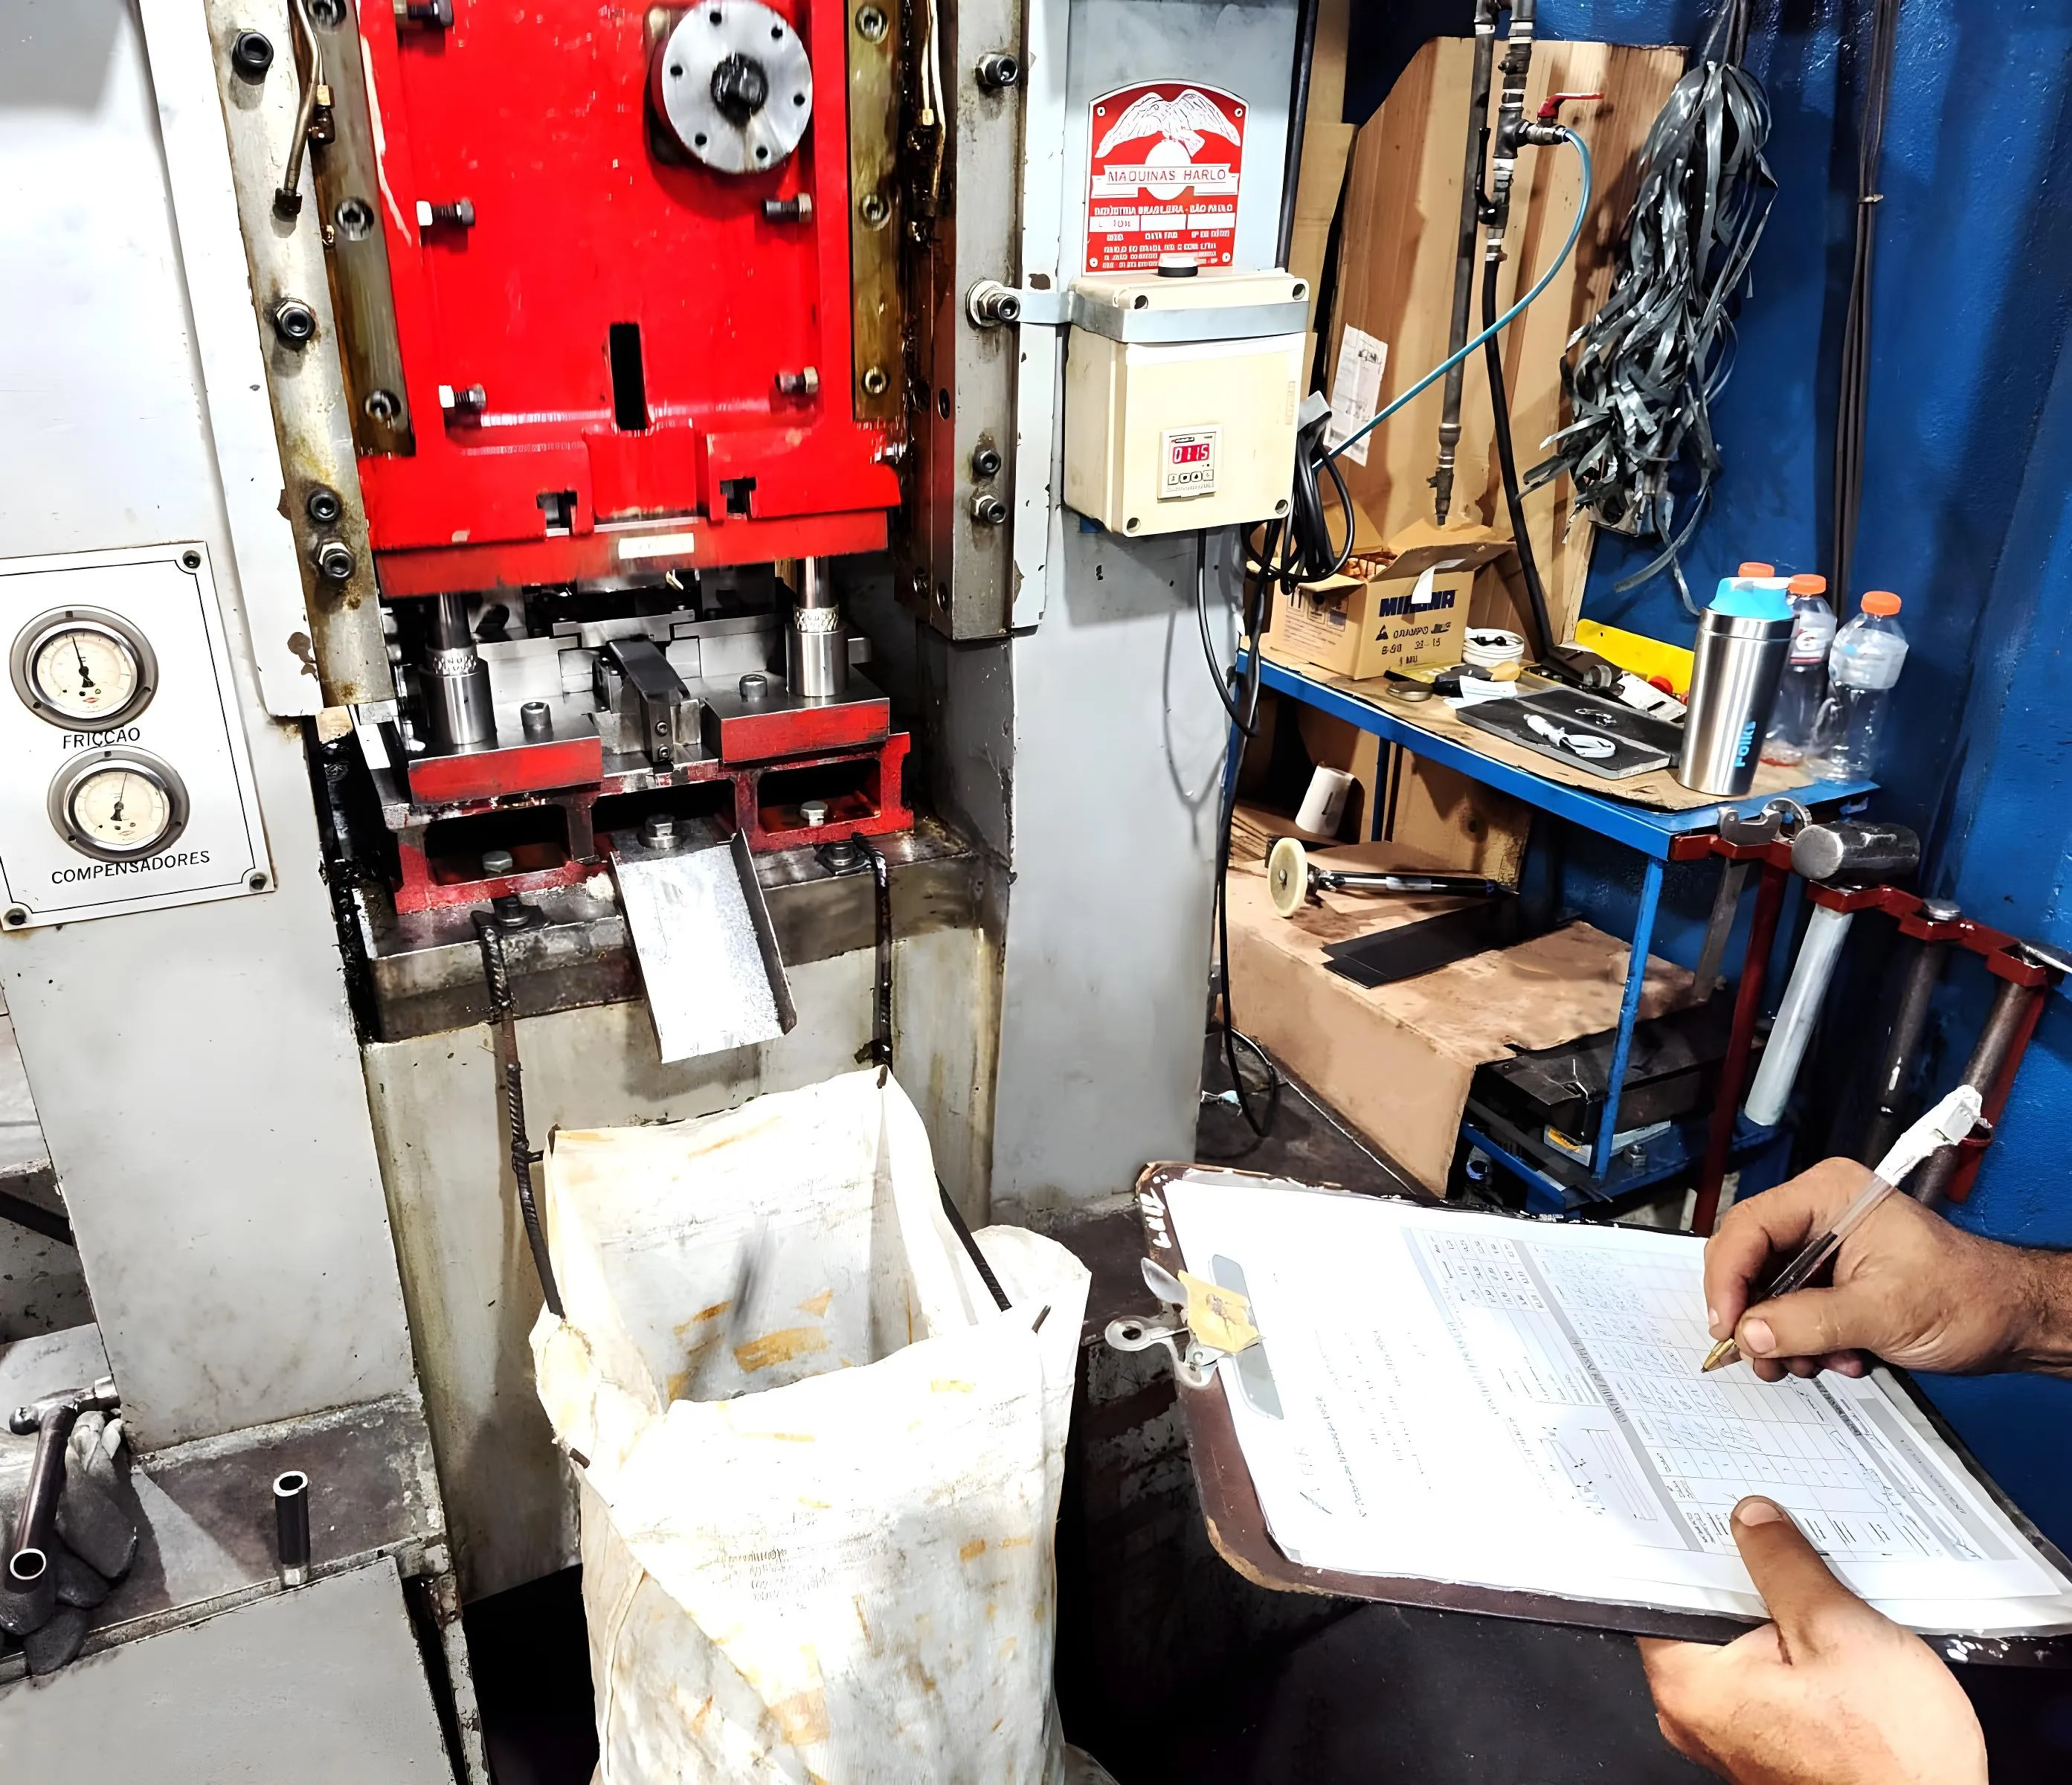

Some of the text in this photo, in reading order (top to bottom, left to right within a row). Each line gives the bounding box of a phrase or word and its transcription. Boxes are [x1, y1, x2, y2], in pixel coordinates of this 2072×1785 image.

[1184, 169, 1226, 180] HARLO
[1174, 445, 1209, 463] 0115
[51, 850, 210, 884] COMPENSADORES
